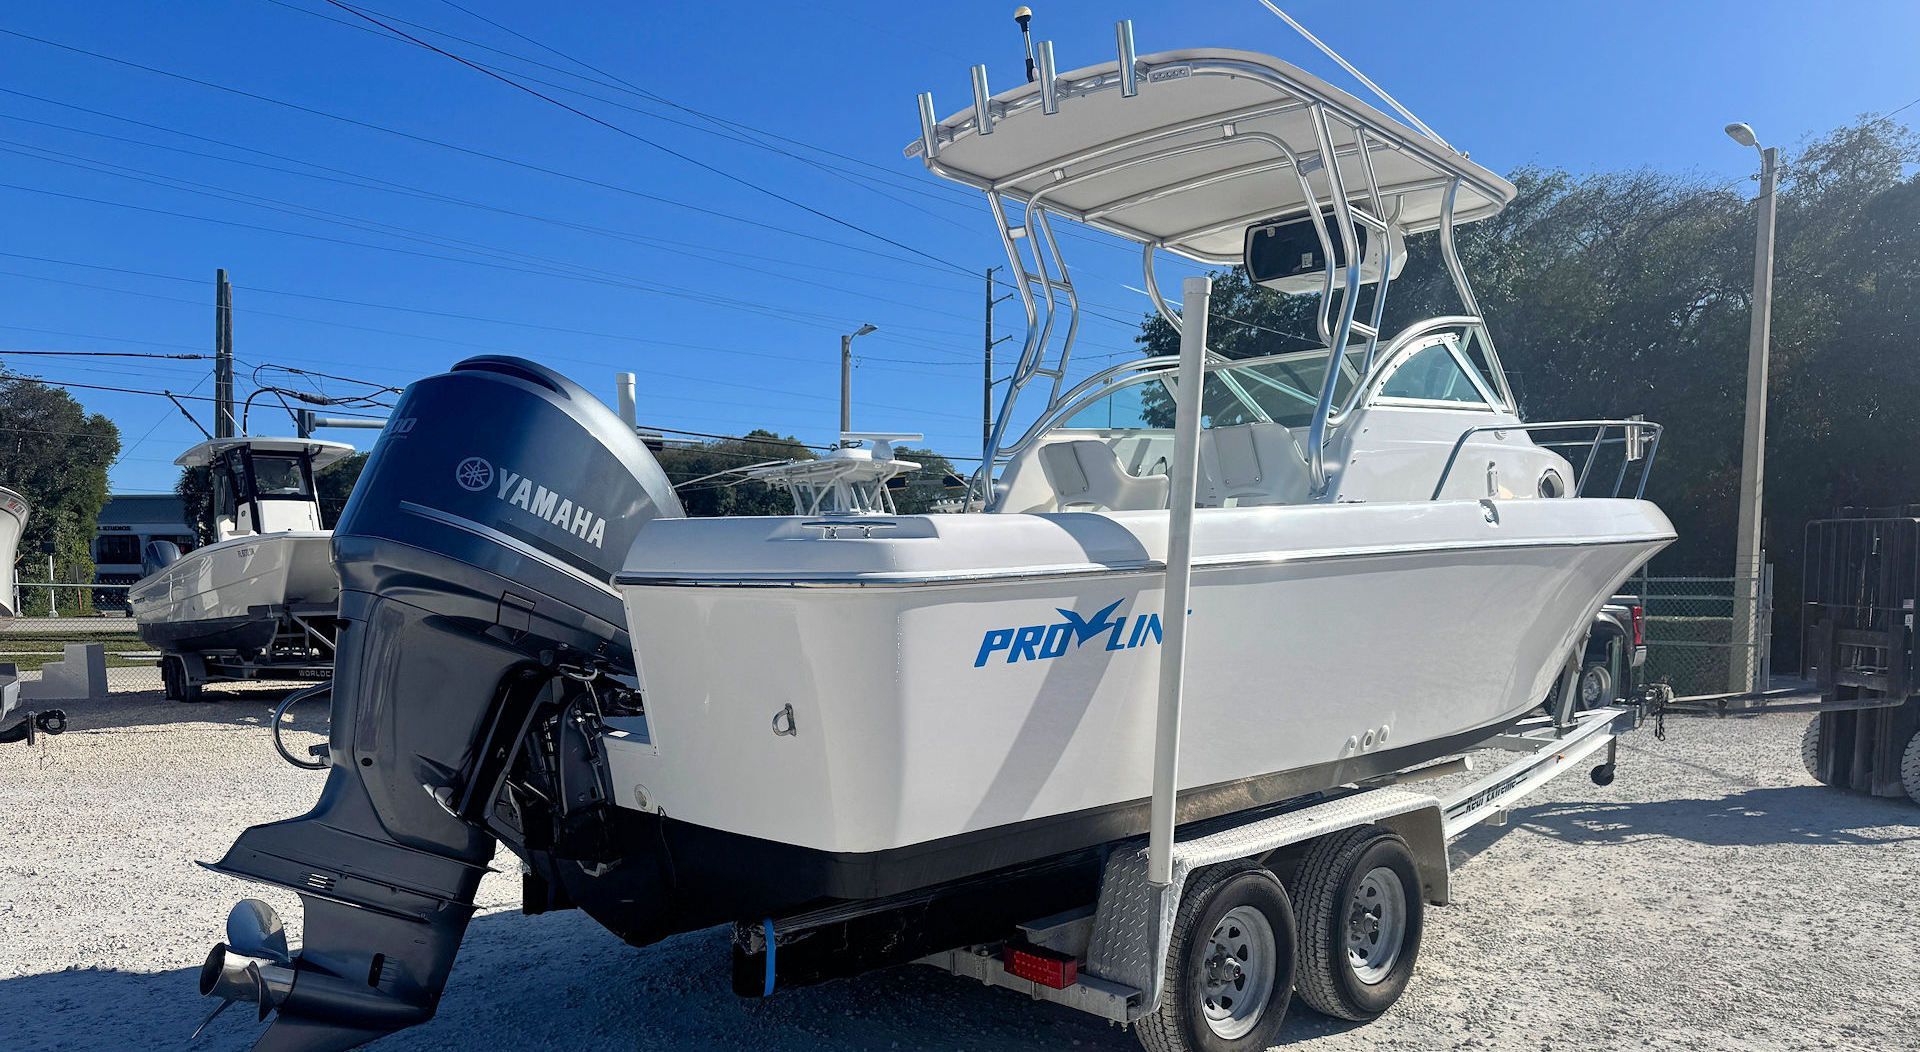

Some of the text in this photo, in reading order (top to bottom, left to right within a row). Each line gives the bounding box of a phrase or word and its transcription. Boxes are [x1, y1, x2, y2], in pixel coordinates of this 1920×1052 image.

[497, 467, 607, 549] YAMAHA
[973, 609, 1193, 668] PRO LIN
[299, 669, 331, 678] WORLDC
